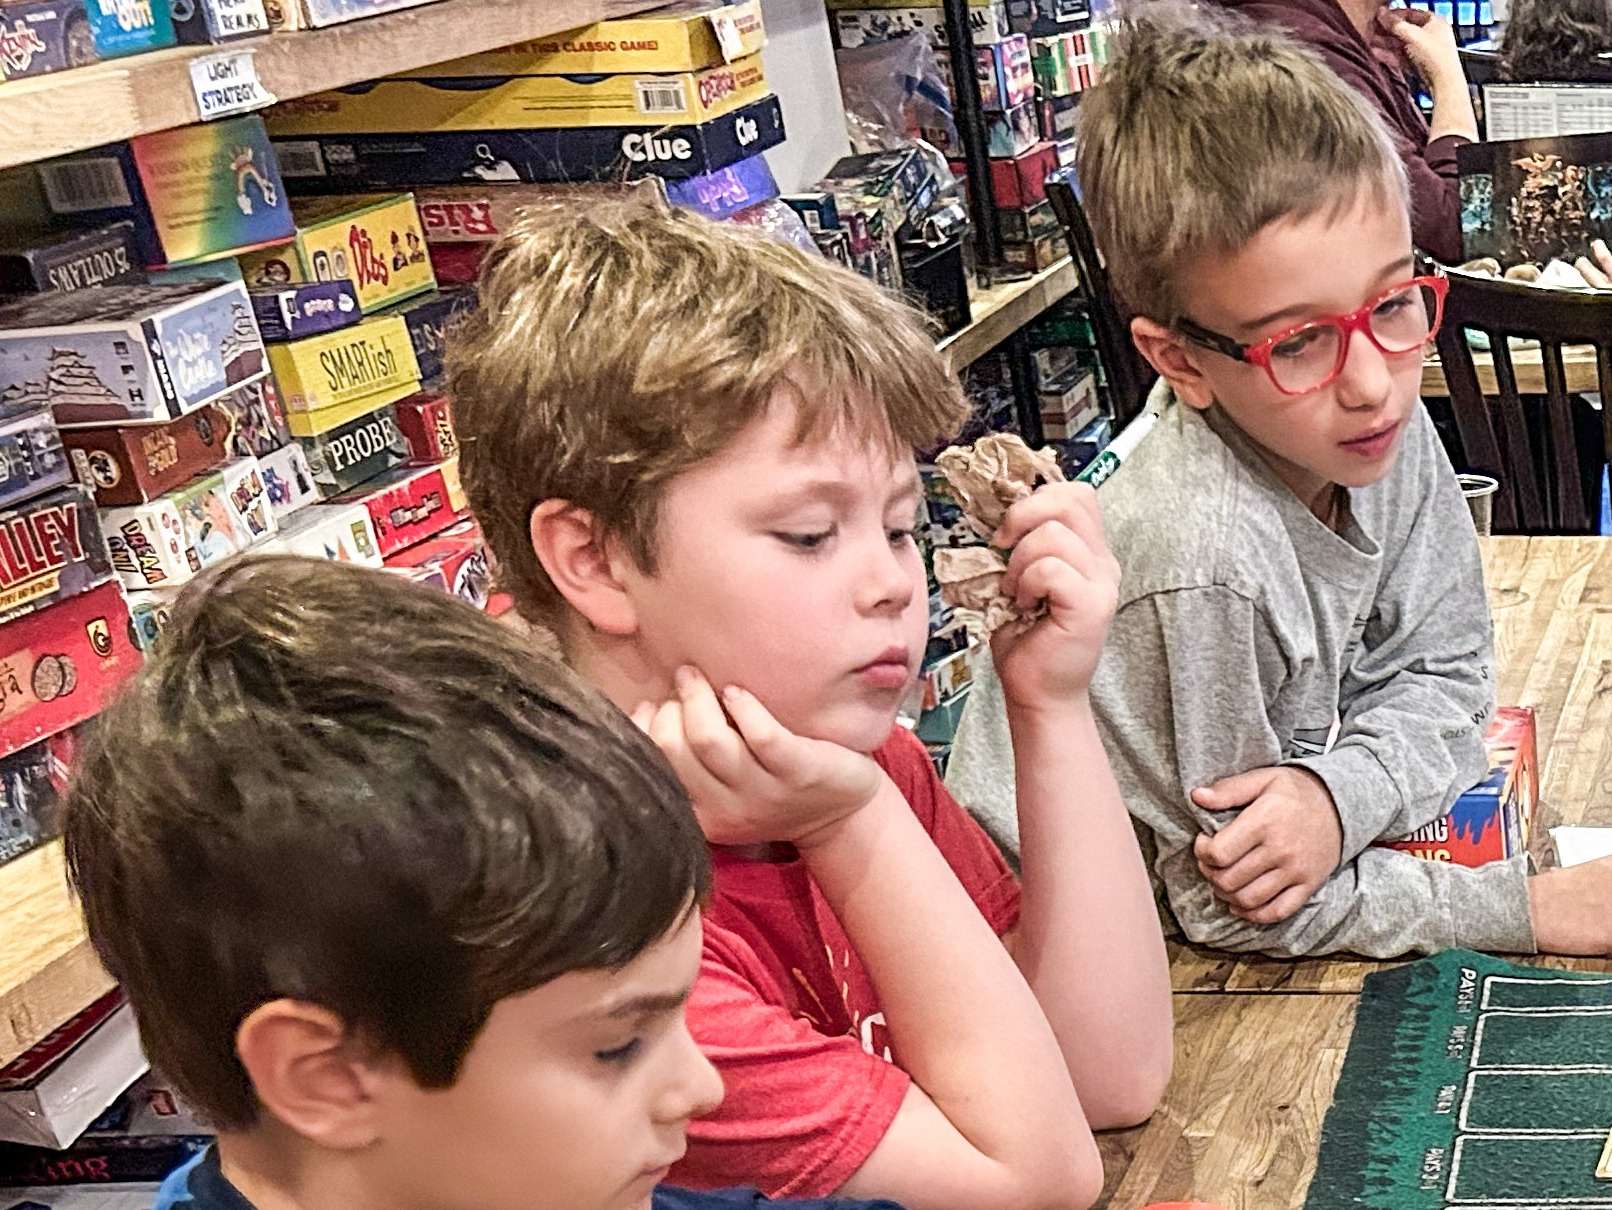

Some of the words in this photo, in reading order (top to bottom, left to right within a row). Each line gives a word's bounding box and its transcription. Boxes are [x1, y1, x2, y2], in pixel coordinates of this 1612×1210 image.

[563, 41, 617, 53] CLASSIC
[207, 60, 240, 81] LIGHT
[202, 83, 259, 110] STRATEGY
[621, 132, 693, 162] Clue
[424, 202, 499, 236] Ris
[319, 336, 398, 392] SMARTish
[328, 415, 397, 472] PROBE
[0, 502, 86, 590] LLEY
[120, 518, 168, 584] DREAM
[1459, 968, 1477, 999] PAYS
